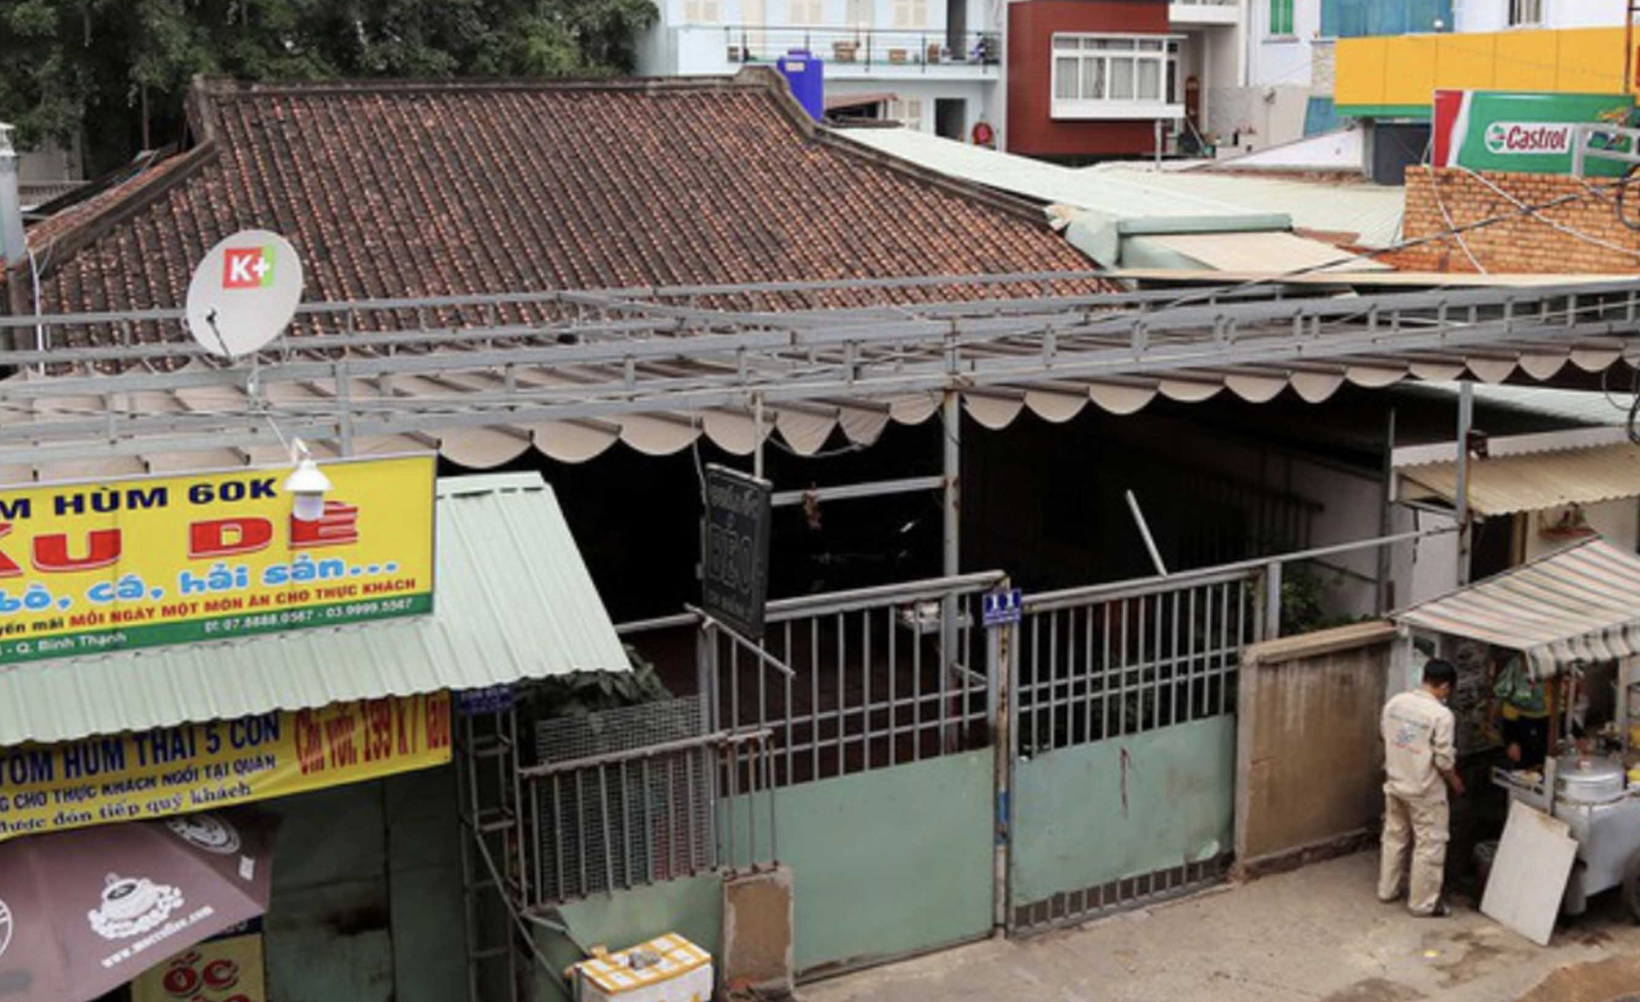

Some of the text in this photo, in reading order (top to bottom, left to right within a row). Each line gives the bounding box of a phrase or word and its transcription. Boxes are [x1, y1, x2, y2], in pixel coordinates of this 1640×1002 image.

[1507, 125, 1568, 149] Castrol
[54, 487, 168, 516] HÙM
[188, 478, 277, 504] 60K
[180, 563, 248, 594] hải
[161, 602, 199, 618] MỘT
[276, 590, 310, 604] CHO
[205, 721, 221, 754] 5
[14, 791, 48, 809] CHO
